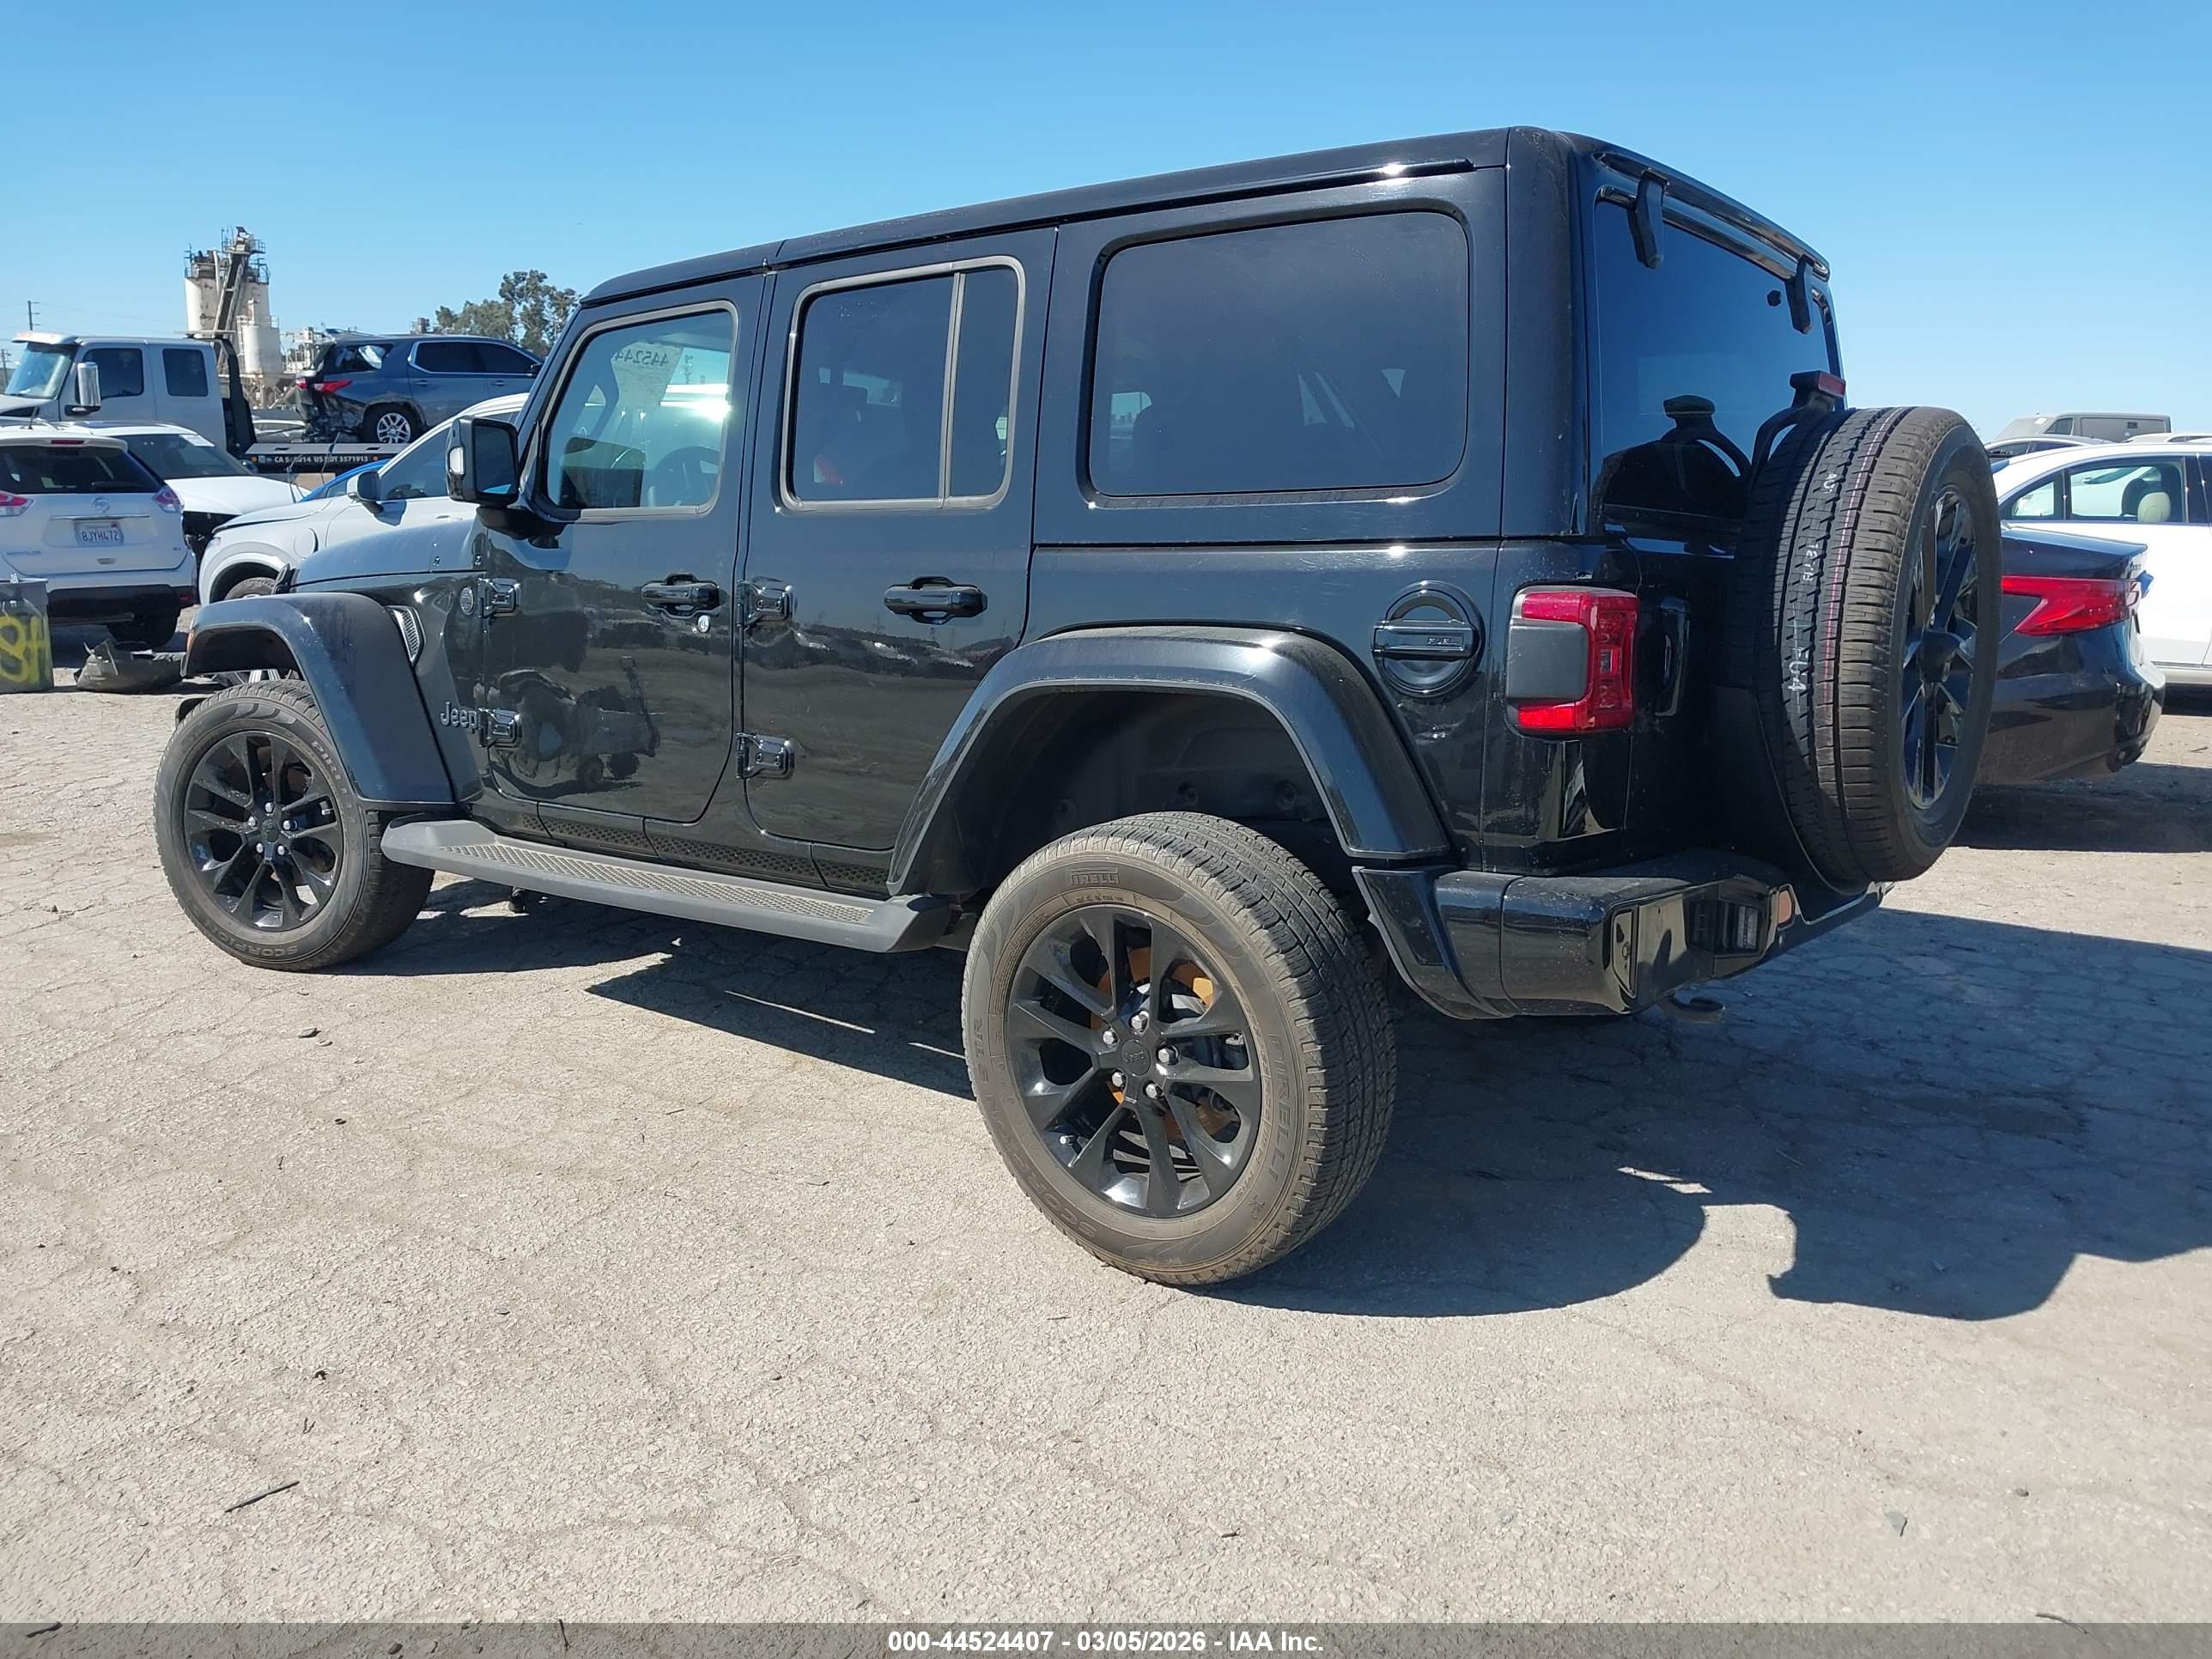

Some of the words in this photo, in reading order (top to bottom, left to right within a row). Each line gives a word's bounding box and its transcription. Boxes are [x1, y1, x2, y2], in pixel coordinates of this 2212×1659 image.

[274, 455, 284, 464] CA
[313, 455, 324, 464] US
[82, 530, 120, 542] 8JYH472
[439, 701, 478, 729] Jeep
[1070, 866, 1120, 886] PIRELLI
